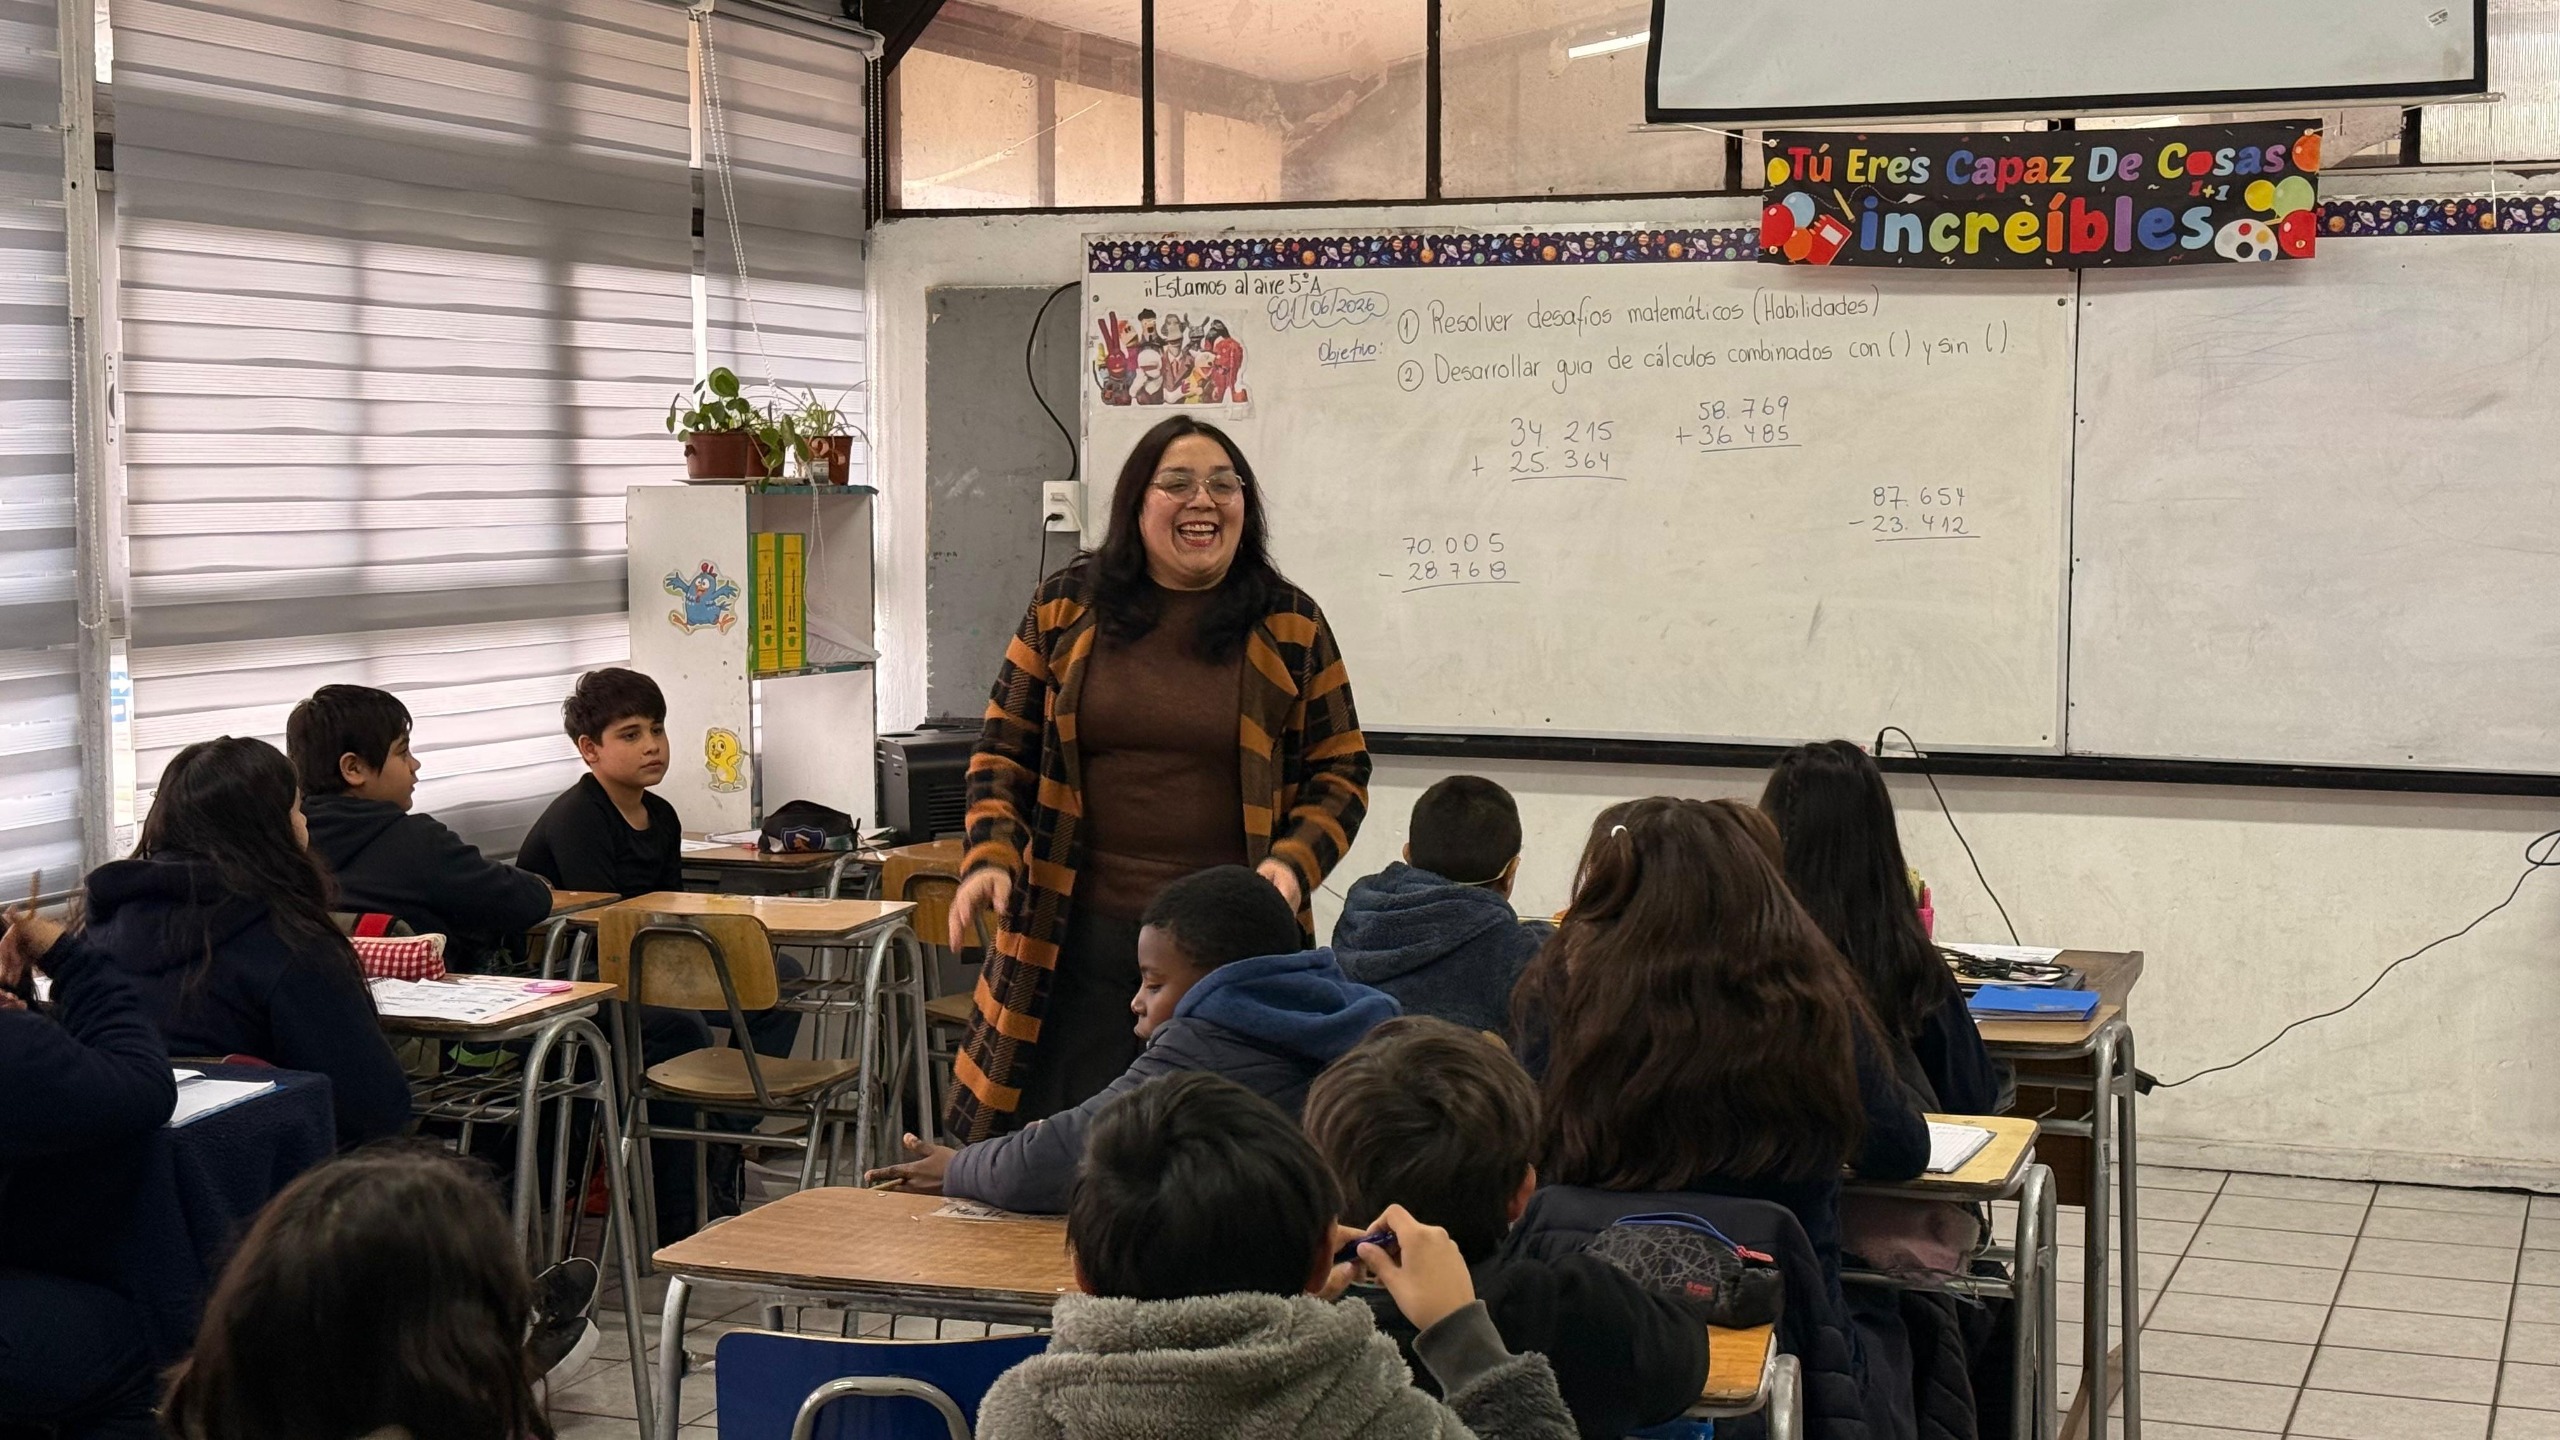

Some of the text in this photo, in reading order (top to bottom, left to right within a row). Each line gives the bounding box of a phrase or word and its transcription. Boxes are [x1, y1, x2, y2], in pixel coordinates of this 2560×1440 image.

[1788, 142, 2287, 193] Tú Eres Capaz De Cosas
[2188, 180, 2231, 201] 1+1
[1860, 192, 2214, 254] increíbles
[1235, 272, 1249, 296] al
[1255, 277, 1285, 295] aire
[1427, 299, 1513, 335] Resolver
[1627, 294, 1744, 324] matemáticos
[1753, 284, 1880, 325] (Habilidades)
[1434, 353, 1541, 384] Desarrollar
[1608, 346, 1634, 370] de
[1643, 342, 1716, 369] cálculos
[1727, 339, 1833, 363] combinados
[1849, 341, 1881, 358] con
[1922, 340, 1931, 366] y
[1938, 338, 1969, 355] sin
